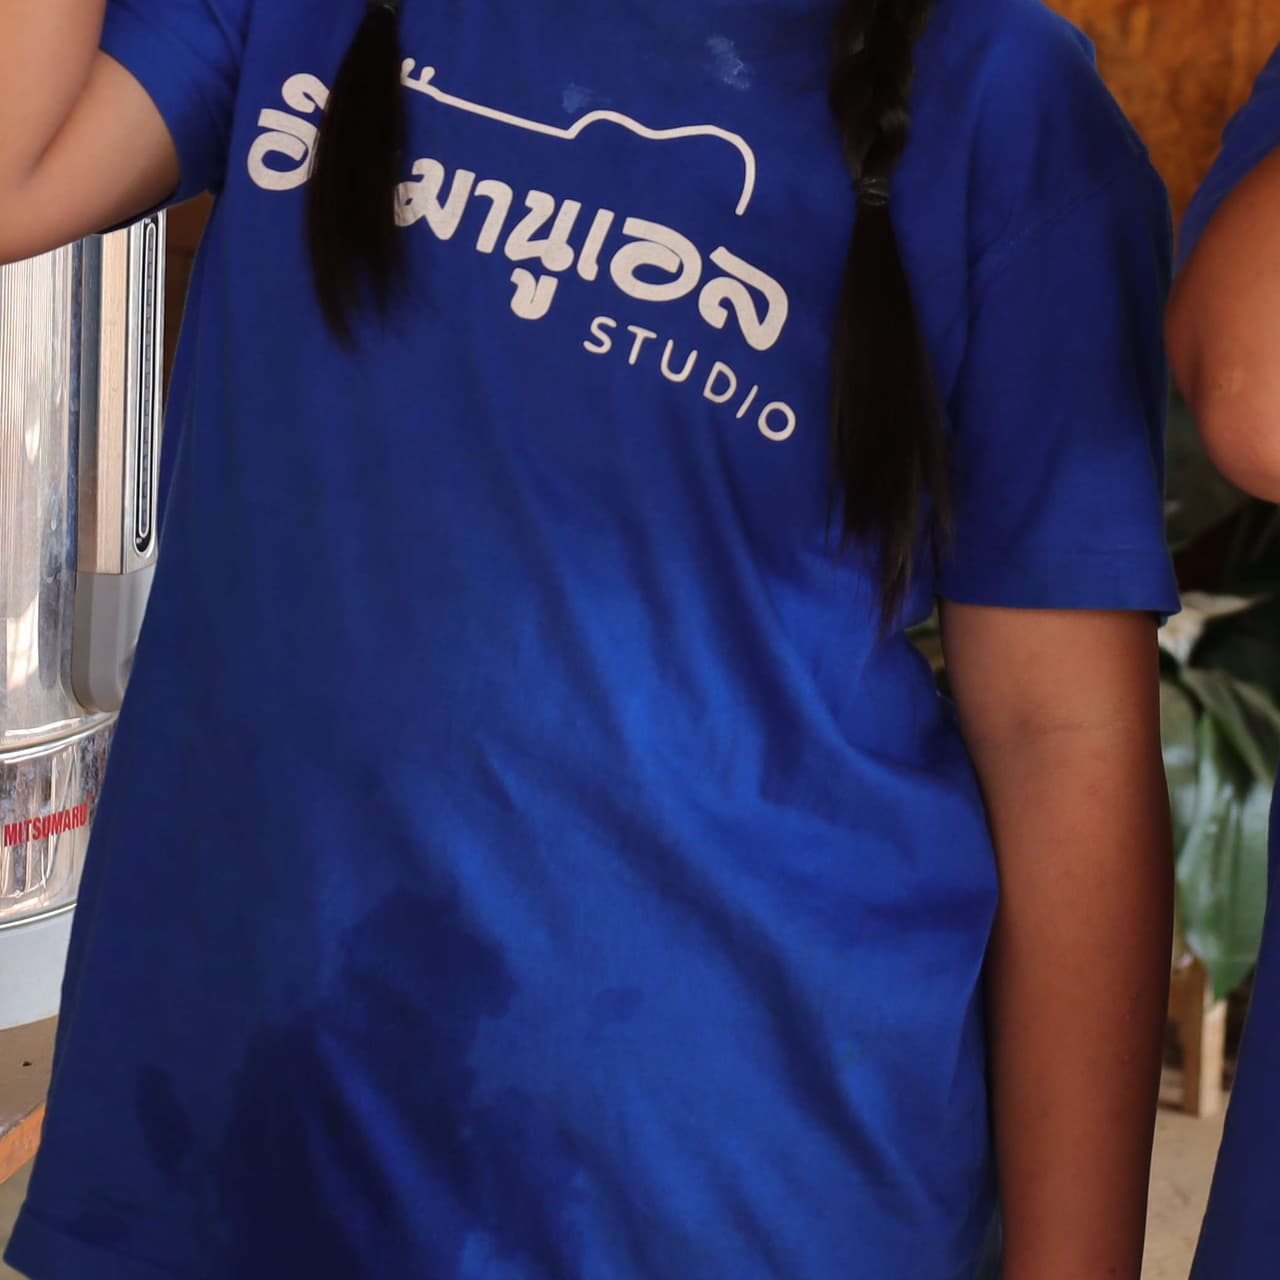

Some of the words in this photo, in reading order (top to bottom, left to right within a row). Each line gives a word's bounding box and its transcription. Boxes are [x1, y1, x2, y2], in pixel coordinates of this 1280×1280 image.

[247, 73, 789, 351] อิมานูเอล
[583, 315, 797, 442] STUDIO
[3, 801, 88, 848] MITSUMARU
